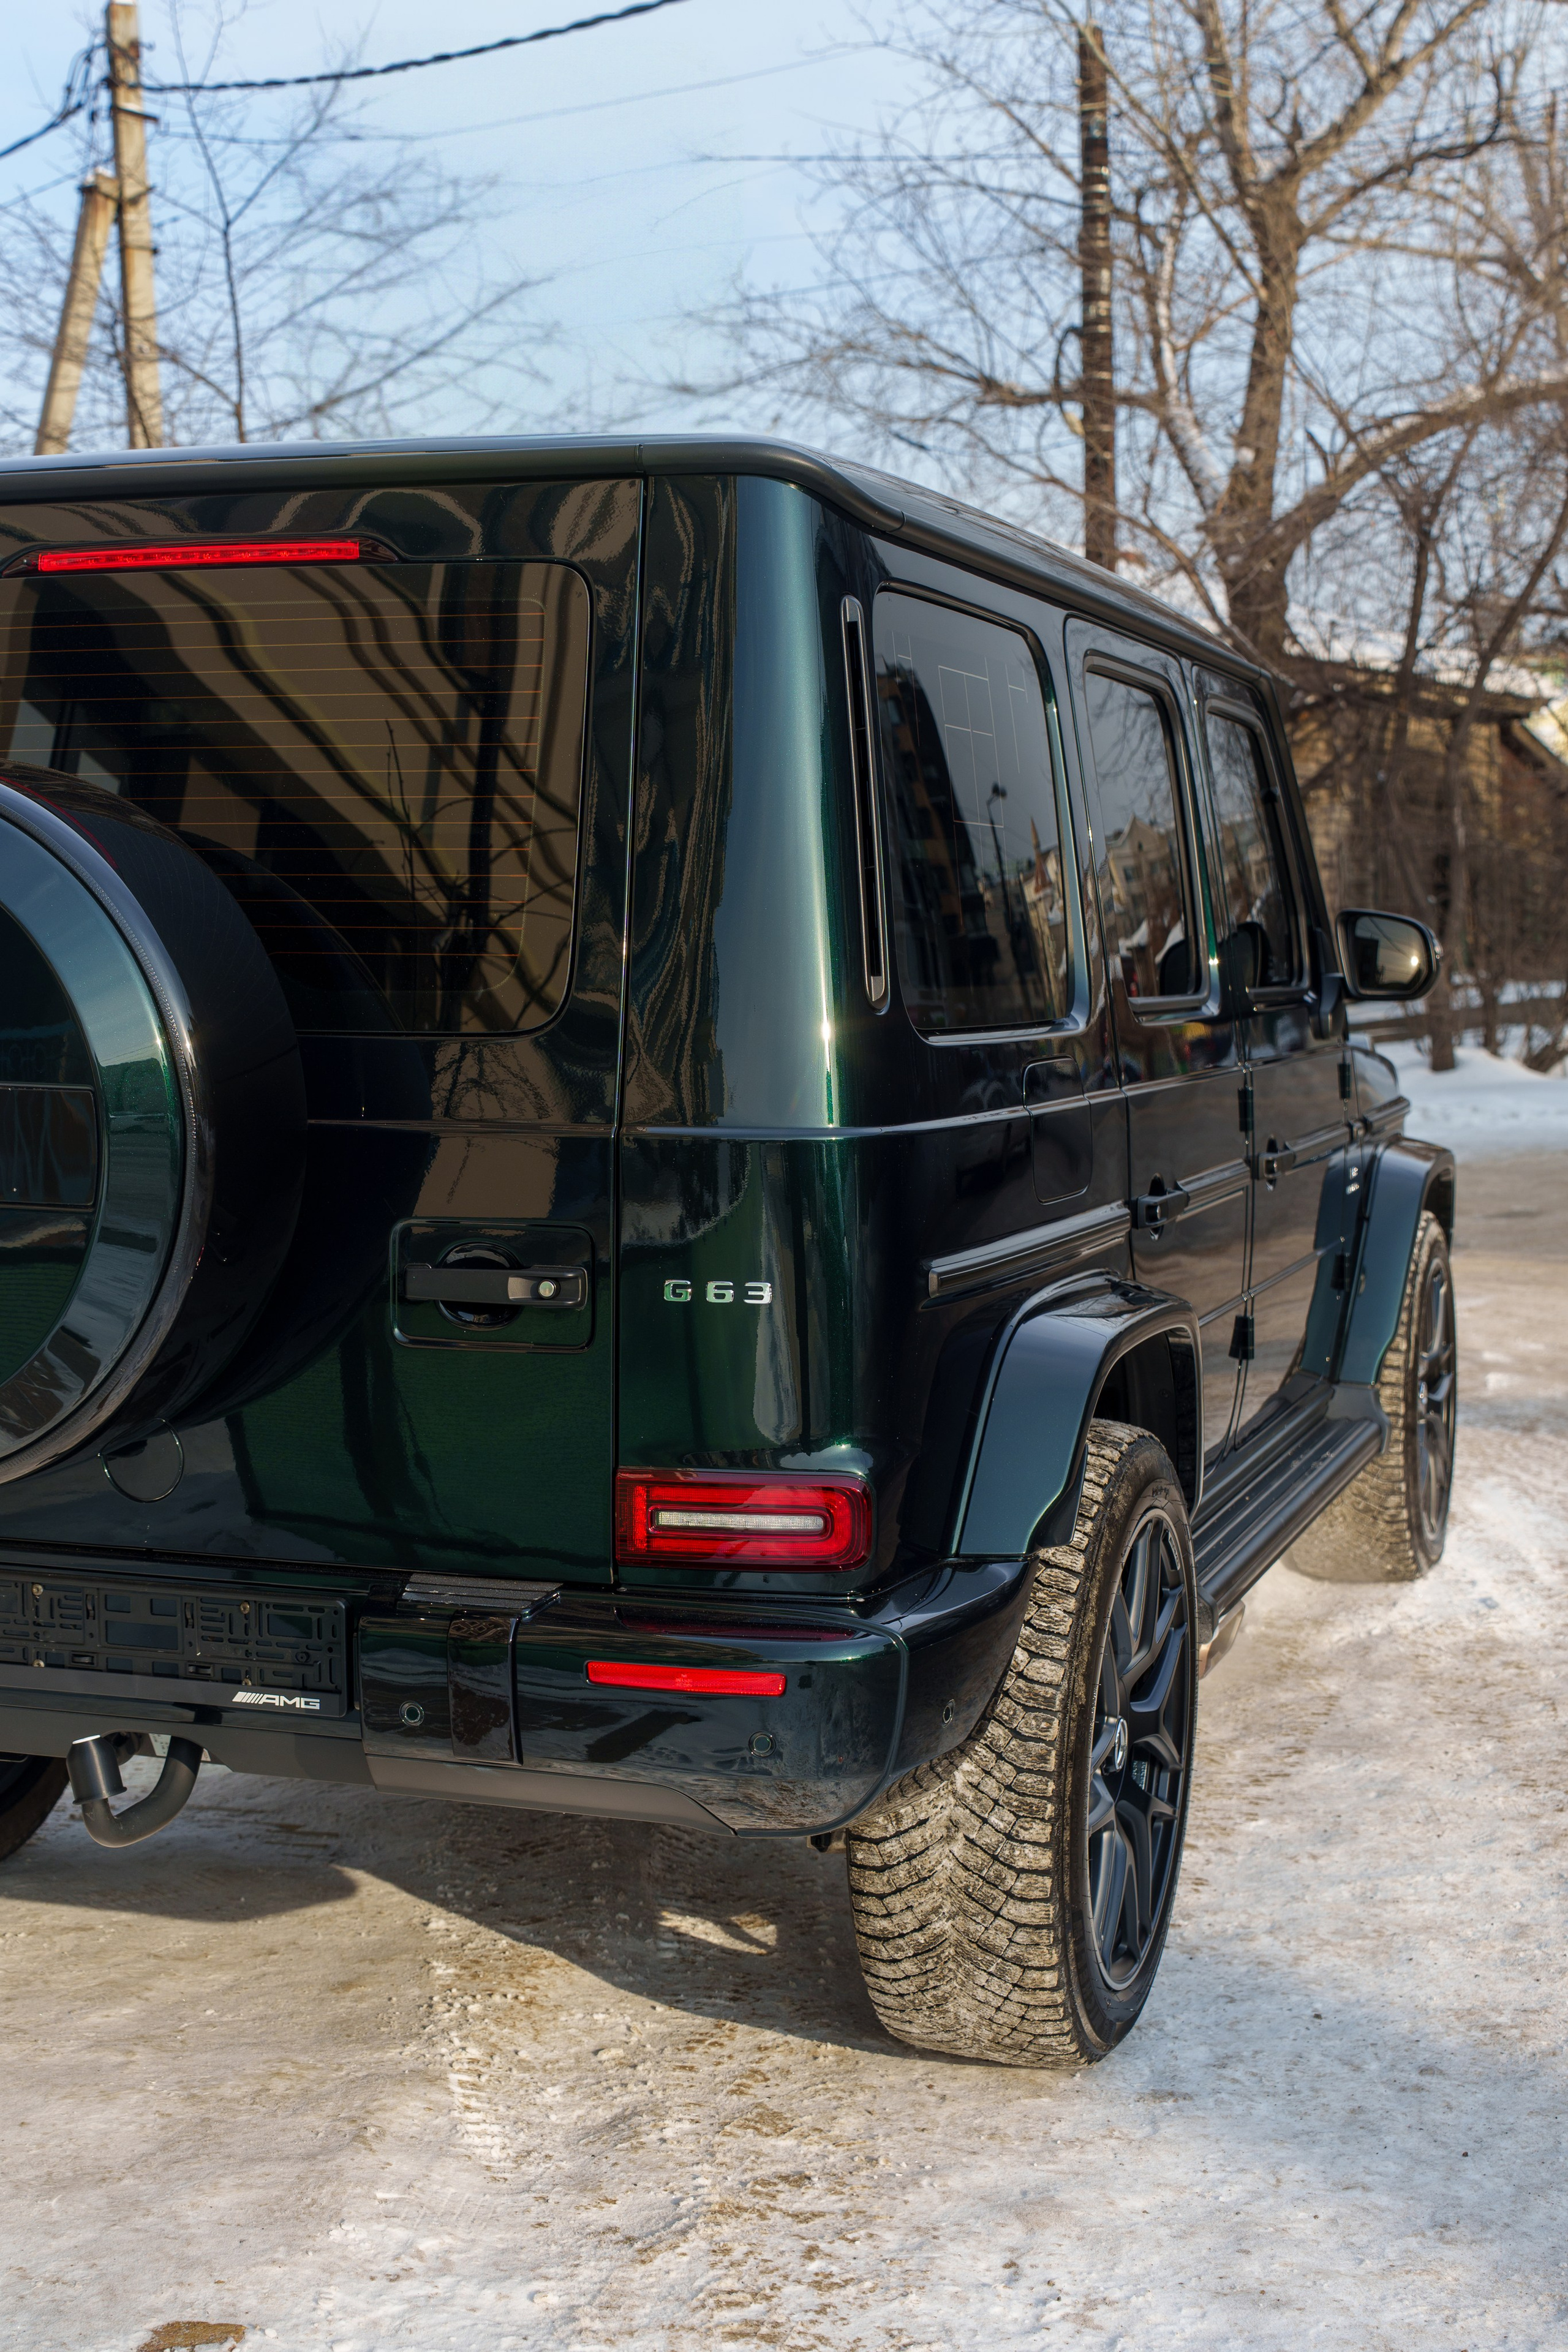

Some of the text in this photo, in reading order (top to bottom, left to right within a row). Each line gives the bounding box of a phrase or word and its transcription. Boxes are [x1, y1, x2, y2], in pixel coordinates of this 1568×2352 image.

[664, 1280, 772, 1304] G 63
[257, 1694, 320, 1710] AMG
